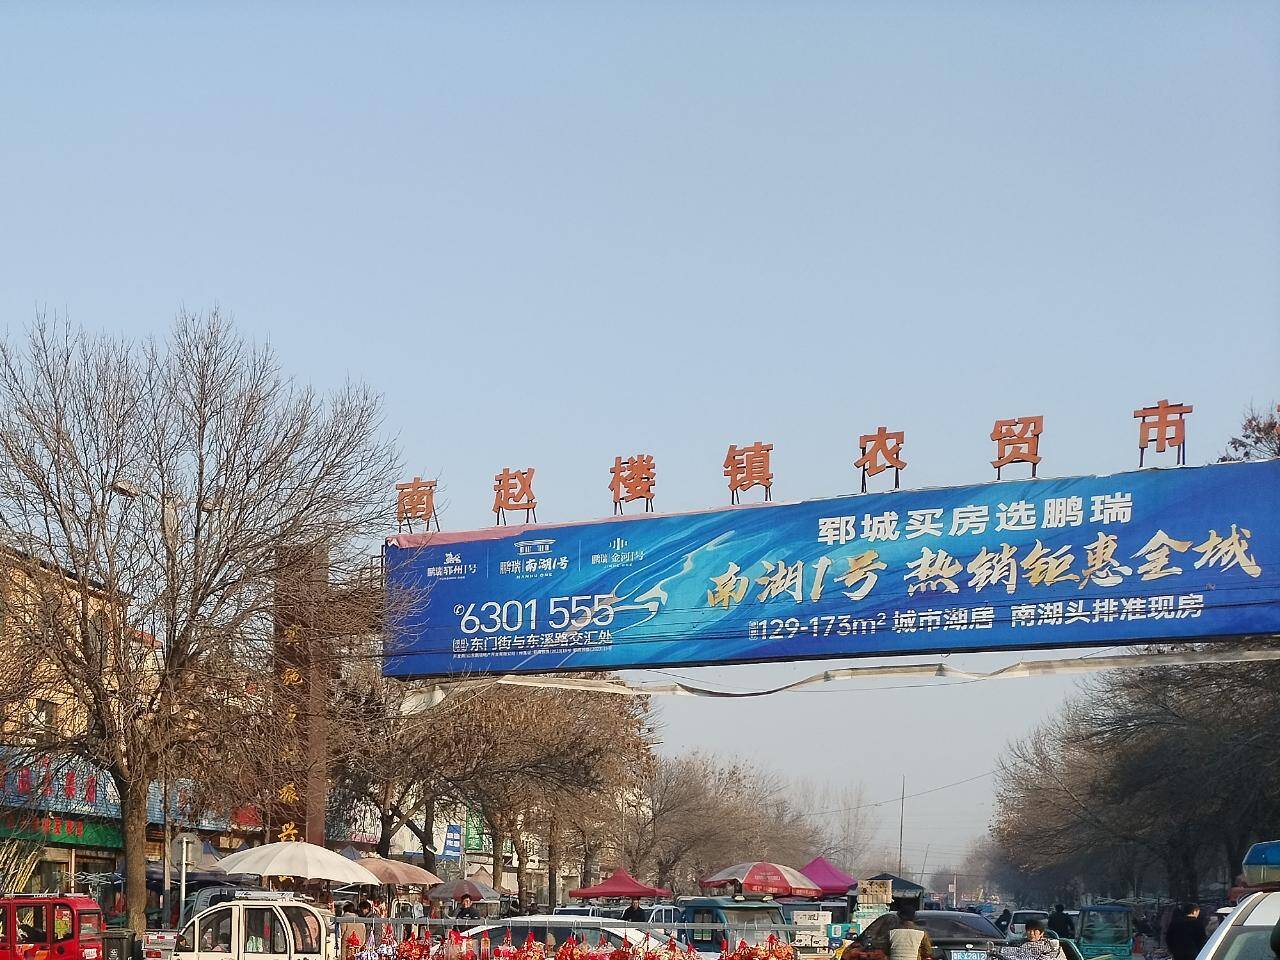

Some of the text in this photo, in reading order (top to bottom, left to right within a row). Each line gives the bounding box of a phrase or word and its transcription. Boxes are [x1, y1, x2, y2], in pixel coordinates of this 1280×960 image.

[395, 398, 1280, 523] 南赵楼镇农贸市
[818, 491, 1133, 545] 郓城买房选鹏瑞
[460, 594, 615, 634] 6301 555
[893, 605, 995, 634] 城市湖居
[1010, 594, 1204, 628] 南湖头排准现房
